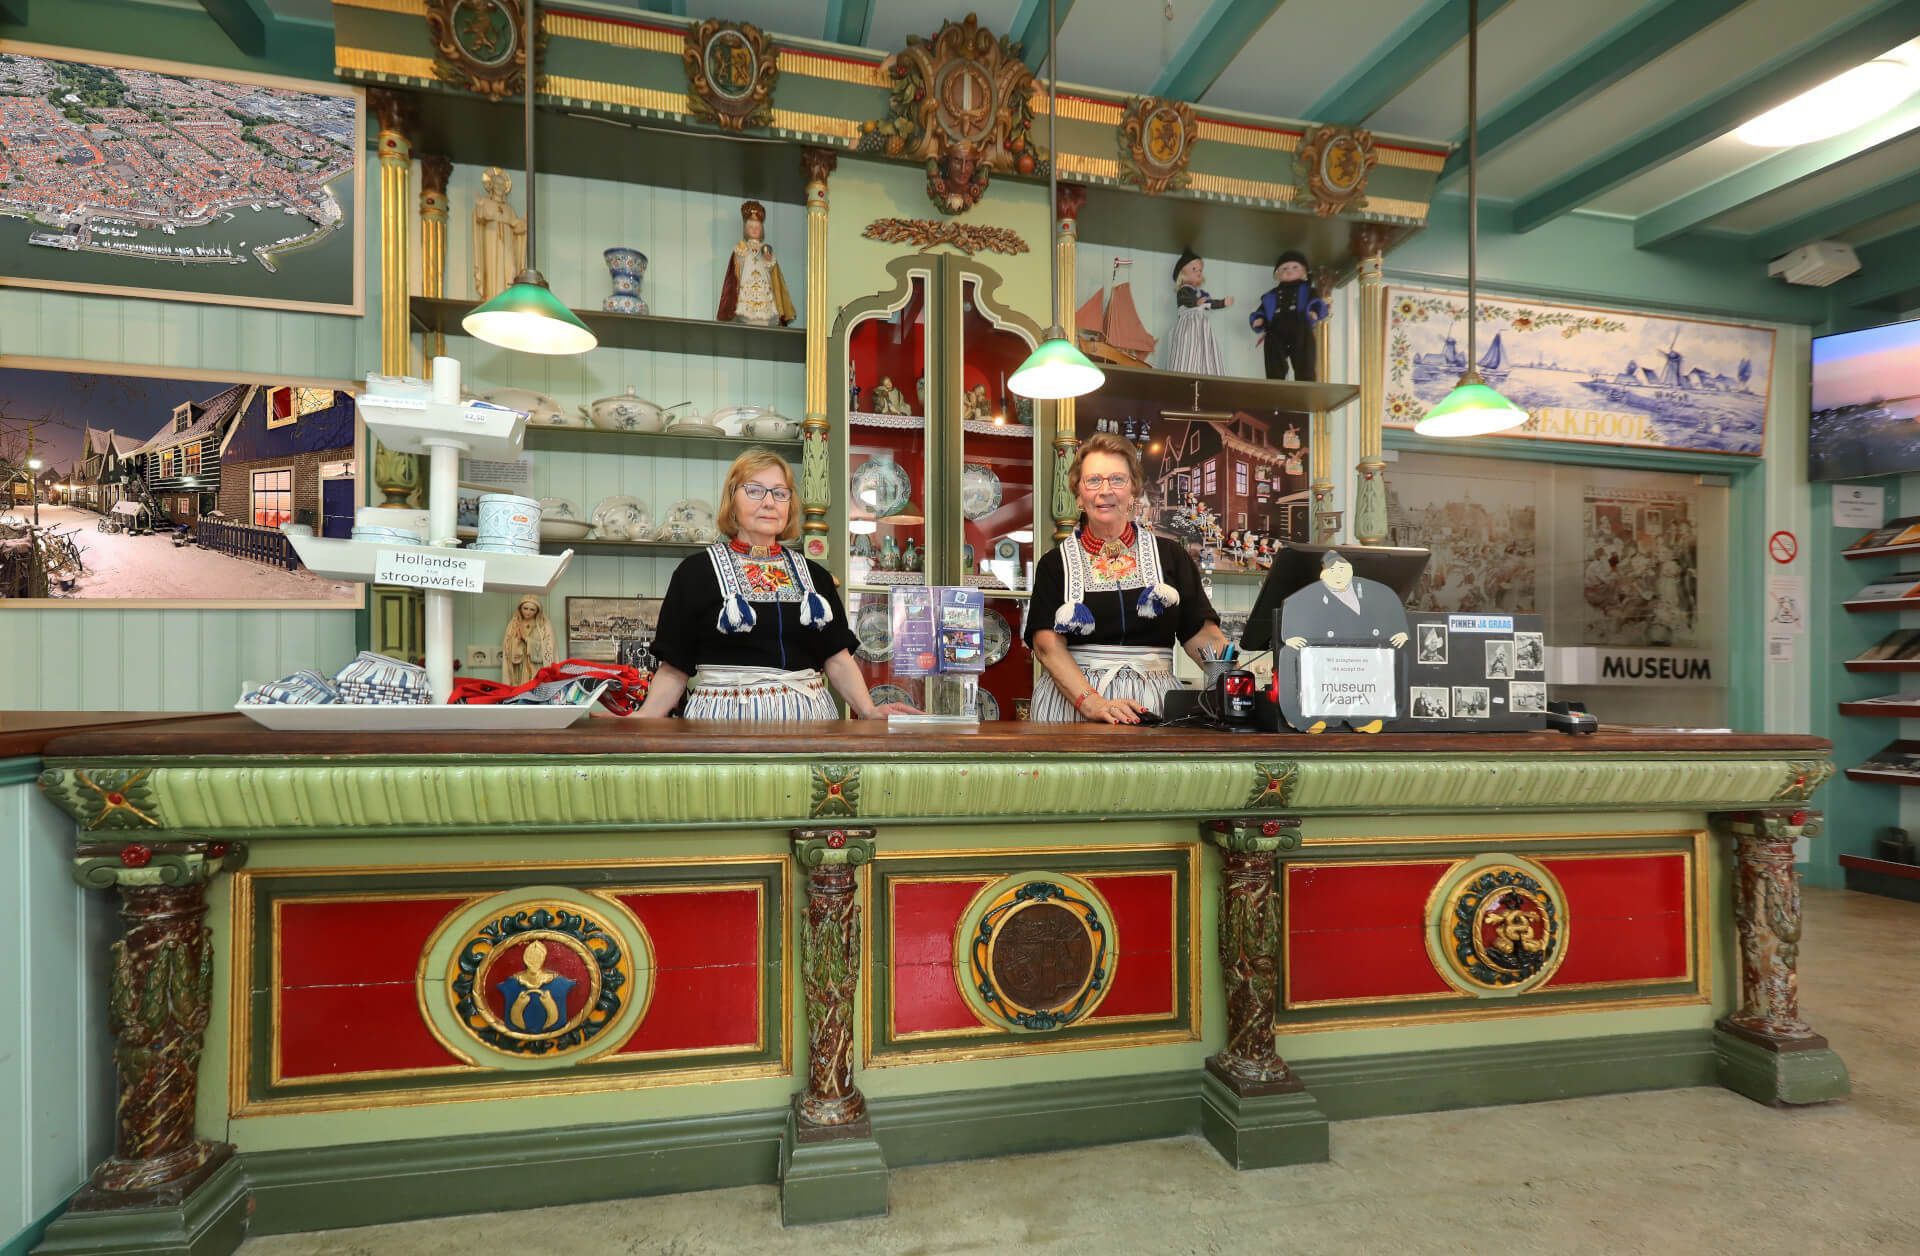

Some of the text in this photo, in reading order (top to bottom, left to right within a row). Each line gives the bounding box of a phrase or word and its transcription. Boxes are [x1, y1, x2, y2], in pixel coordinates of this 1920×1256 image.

[395, 553, 467, 569] Hollandse
[381, 571, 475, 588] stroopwafels
[1451, 619, 1476, 628] PINNEN
[1602, 655, 1711, 680] MUSEUM
[1321, 682, 1377, 693] museum
